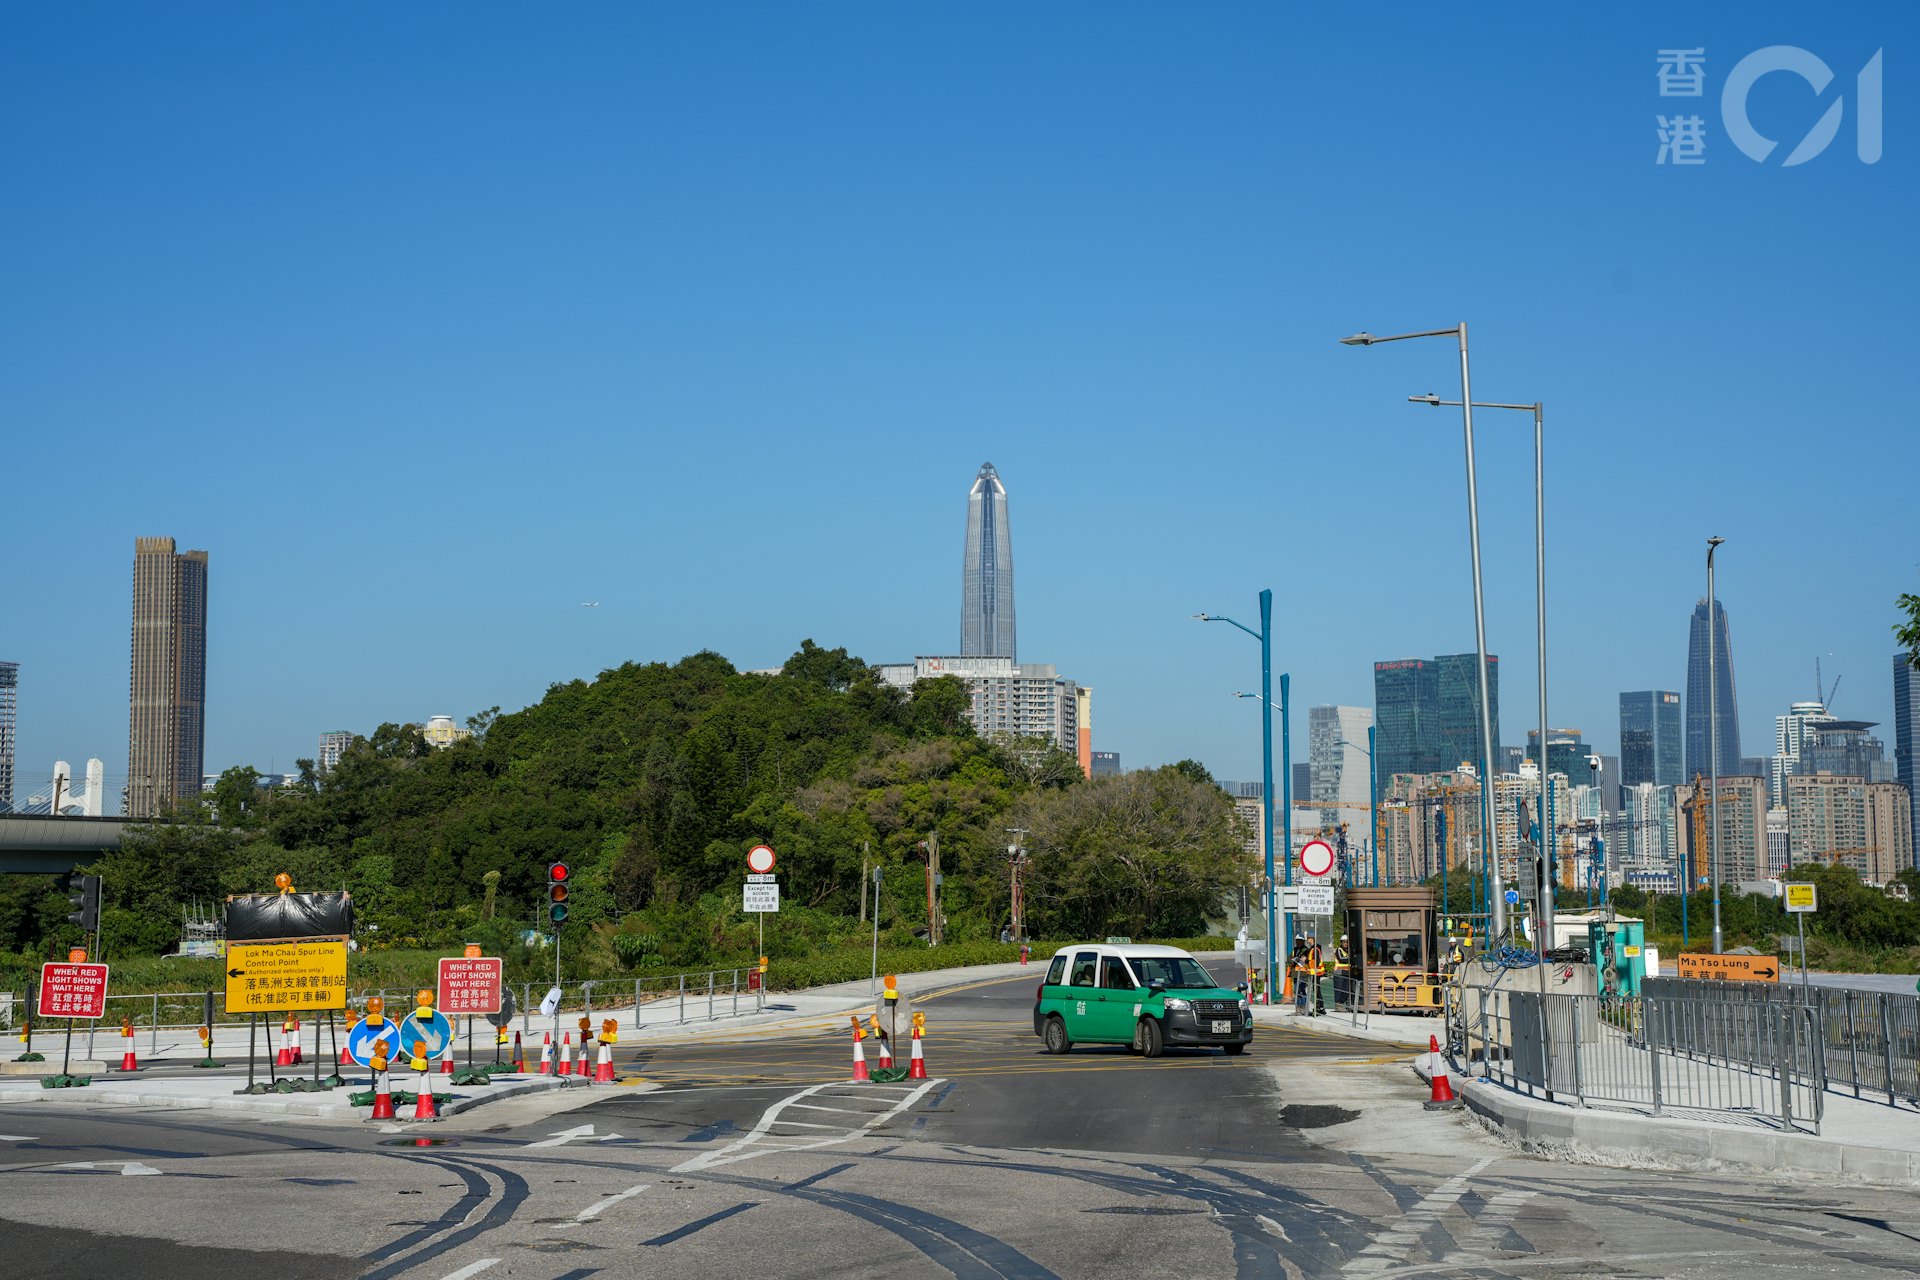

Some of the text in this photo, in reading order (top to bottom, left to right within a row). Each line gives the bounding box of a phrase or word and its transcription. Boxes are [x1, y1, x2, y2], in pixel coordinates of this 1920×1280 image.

[298, 948, 316, 957] Spur
[245, 959, 276, 967] Control
[1700, 958, 1719, 967] Tso
[1722, 959, 1749, 969] Lung
[245, 975, 346, 990] 落馬洲支線管制站
[53, 993, 93, 1003] 紅燈亮時
[450, 989, 489, 999] 紅燈亮時
[52, 1003, 92, 1012] 在此等候
[450, 999, 489, 1008] 在此等候
